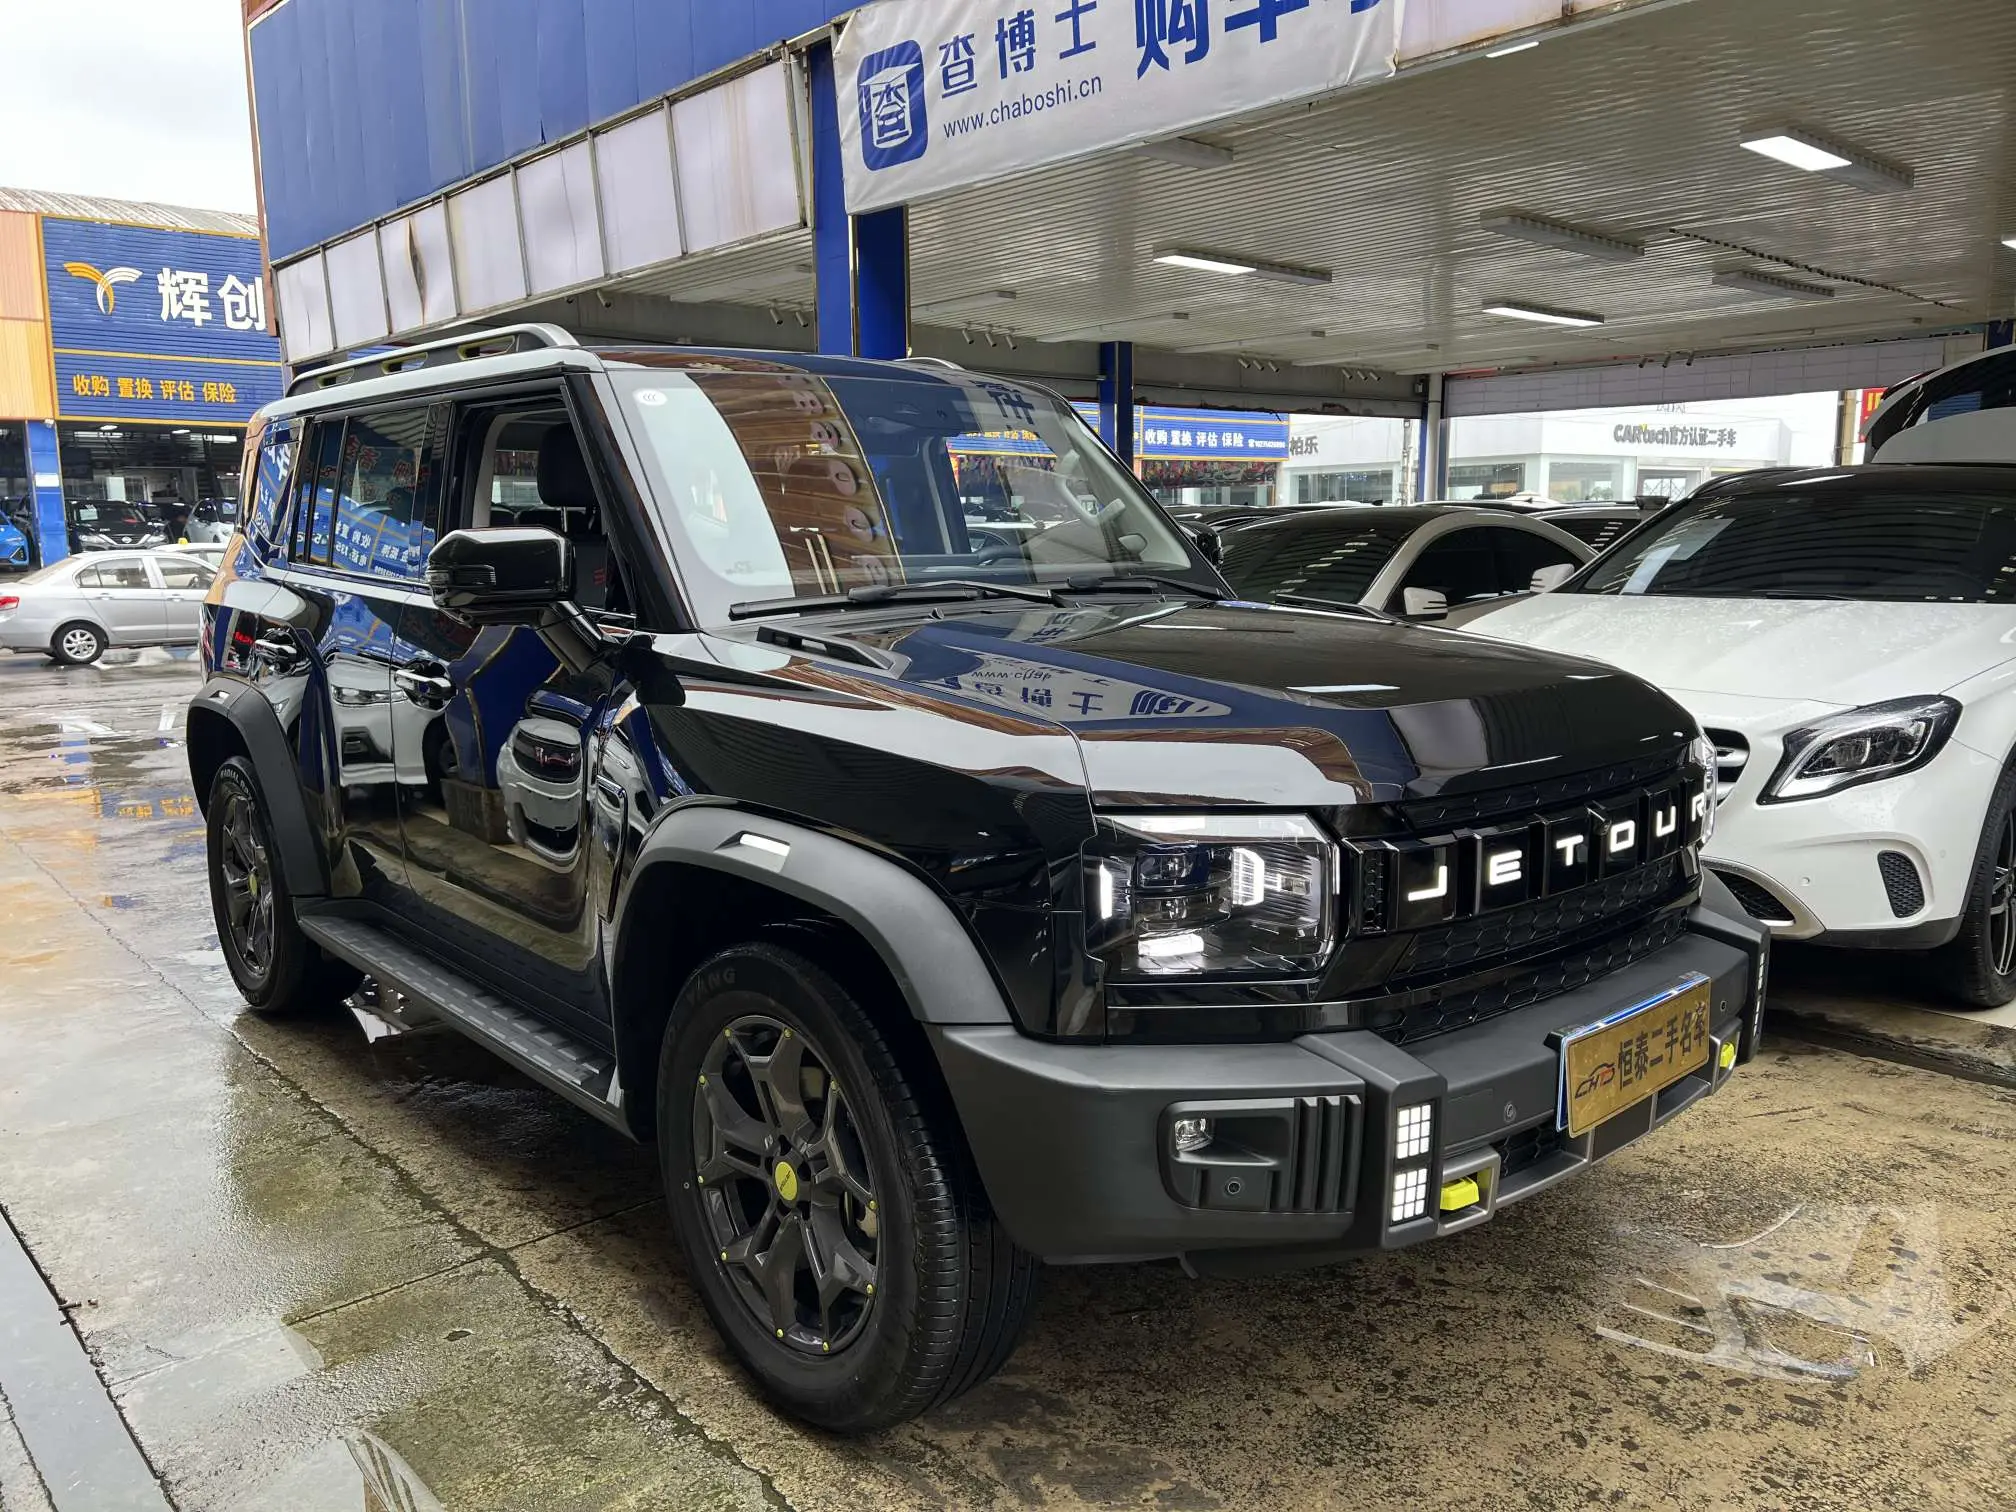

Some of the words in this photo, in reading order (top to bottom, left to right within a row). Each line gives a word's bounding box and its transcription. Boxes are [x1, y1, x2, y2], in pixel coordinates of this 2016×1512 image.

[938, 0, 1098, 99] 查博士
[943, 75, 1102, 138] www.chaboshi.cn
[156, 267, 266, 330] 辉创
[73, 375, 110, 396] 收购
[118, 377, 153, 400] 置换
[160, 380, 195, 401] 评估
[202, 382, 236, 403] 保险
[1145, 429, 1167, 445] 收购
[1196, 431, 1218, 447] 评估
[1222, 432, 1244, 447] 保险
[1407, 792, 1706, 901] JETOUR
